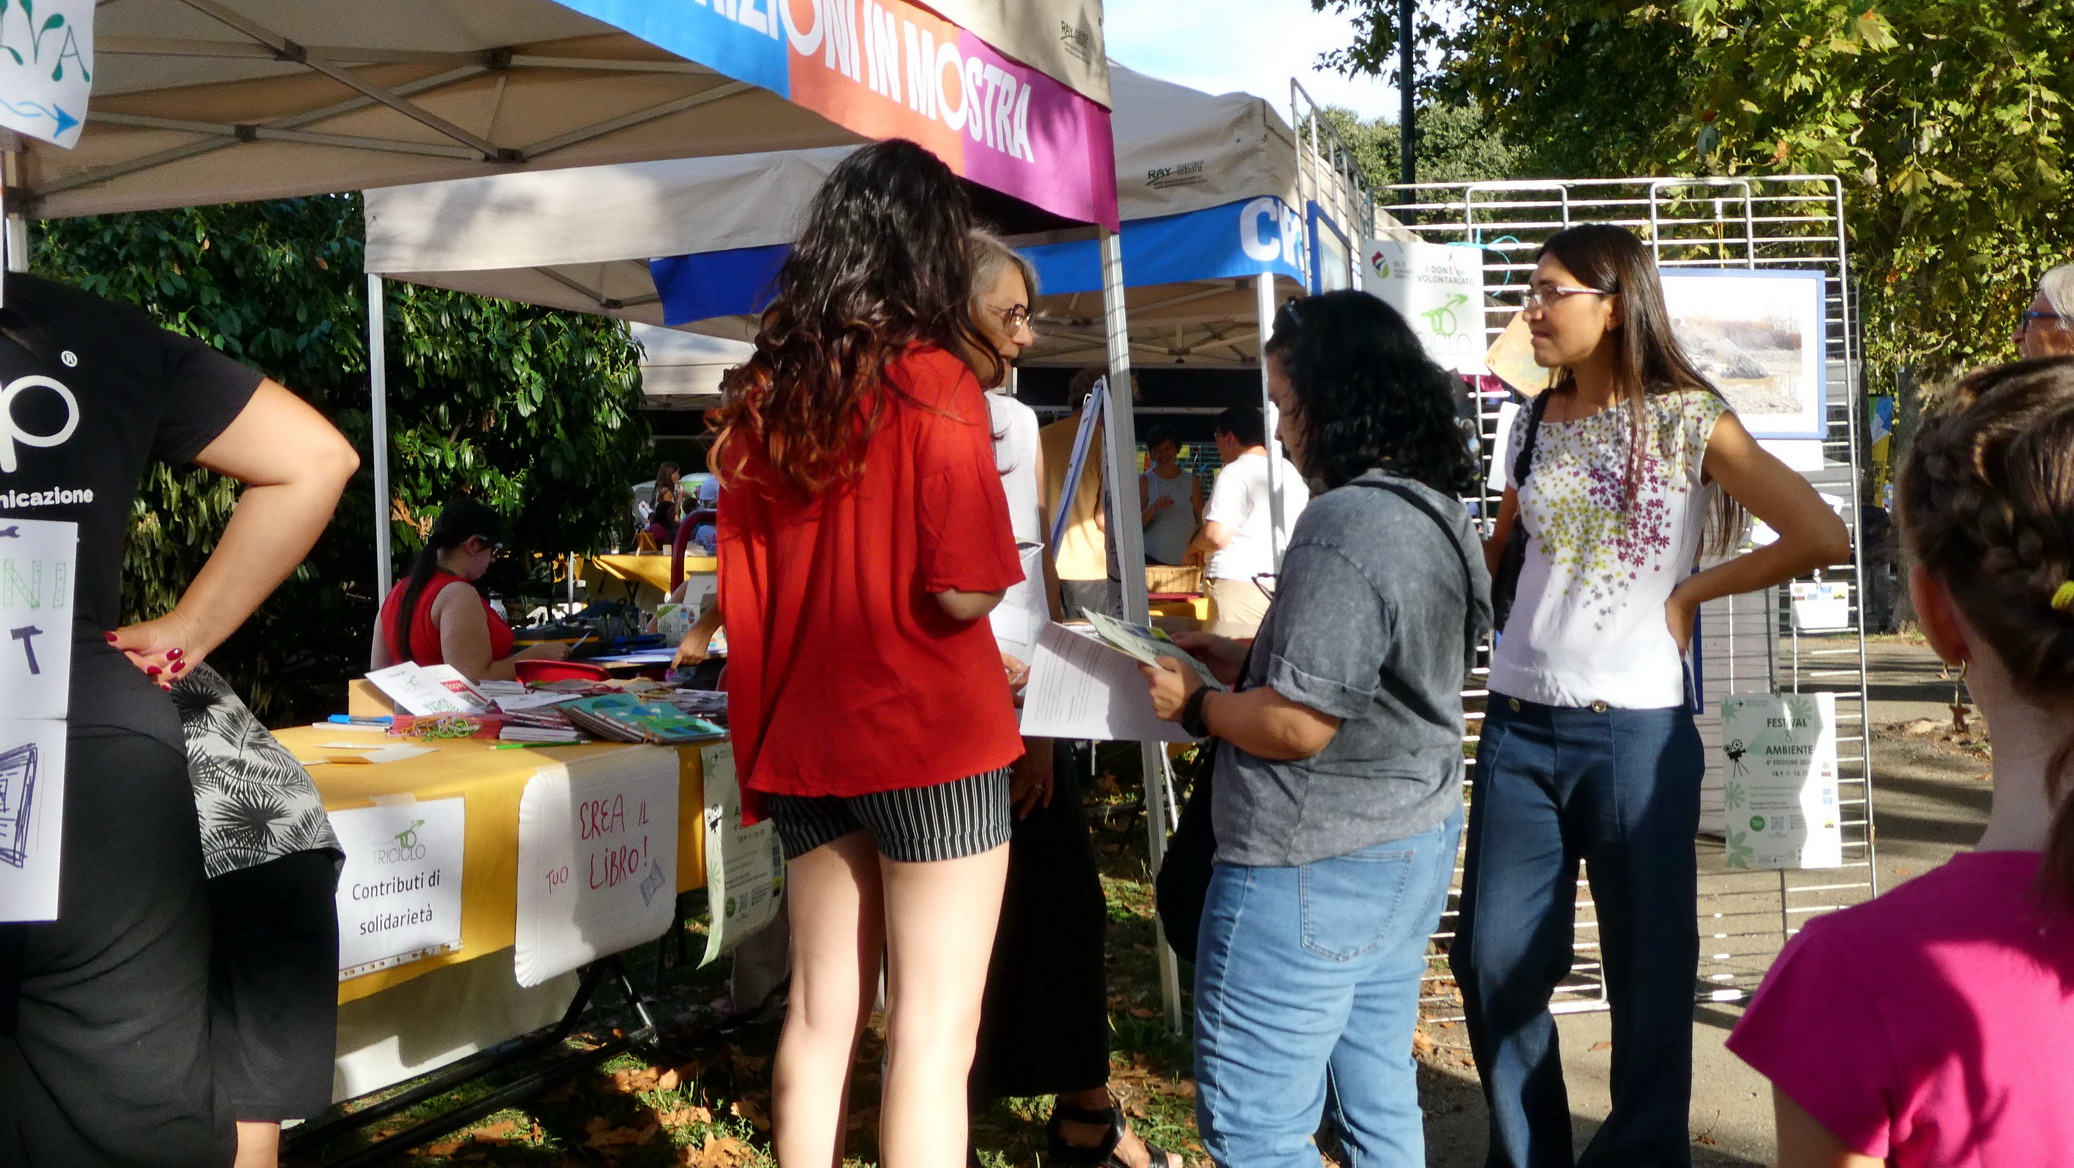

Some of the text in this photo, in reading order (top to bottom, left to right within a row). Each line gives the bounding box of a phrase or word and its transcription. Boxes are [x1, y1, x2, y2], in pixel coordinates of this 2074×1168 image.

[863, 0, 902, 103] IN
[903, 19, 1035, 164] MOSTRA
[1148, 167, 1172, 179] RAY
[1417, 274, 1475, 286] VOLONTARIATO
[1766, 718, 1808, 728] FESTVAL
[1765, 745, 1813, 755] AMBIENTE
[579, 794, 650, 840] CREA IL
[371, 844, 427, 865] TRICICLO
[352, 869, 440, 901] Contributi di
[545, 866, 569, 895] TUO
[360, 904, 433, 936] solidarietà
